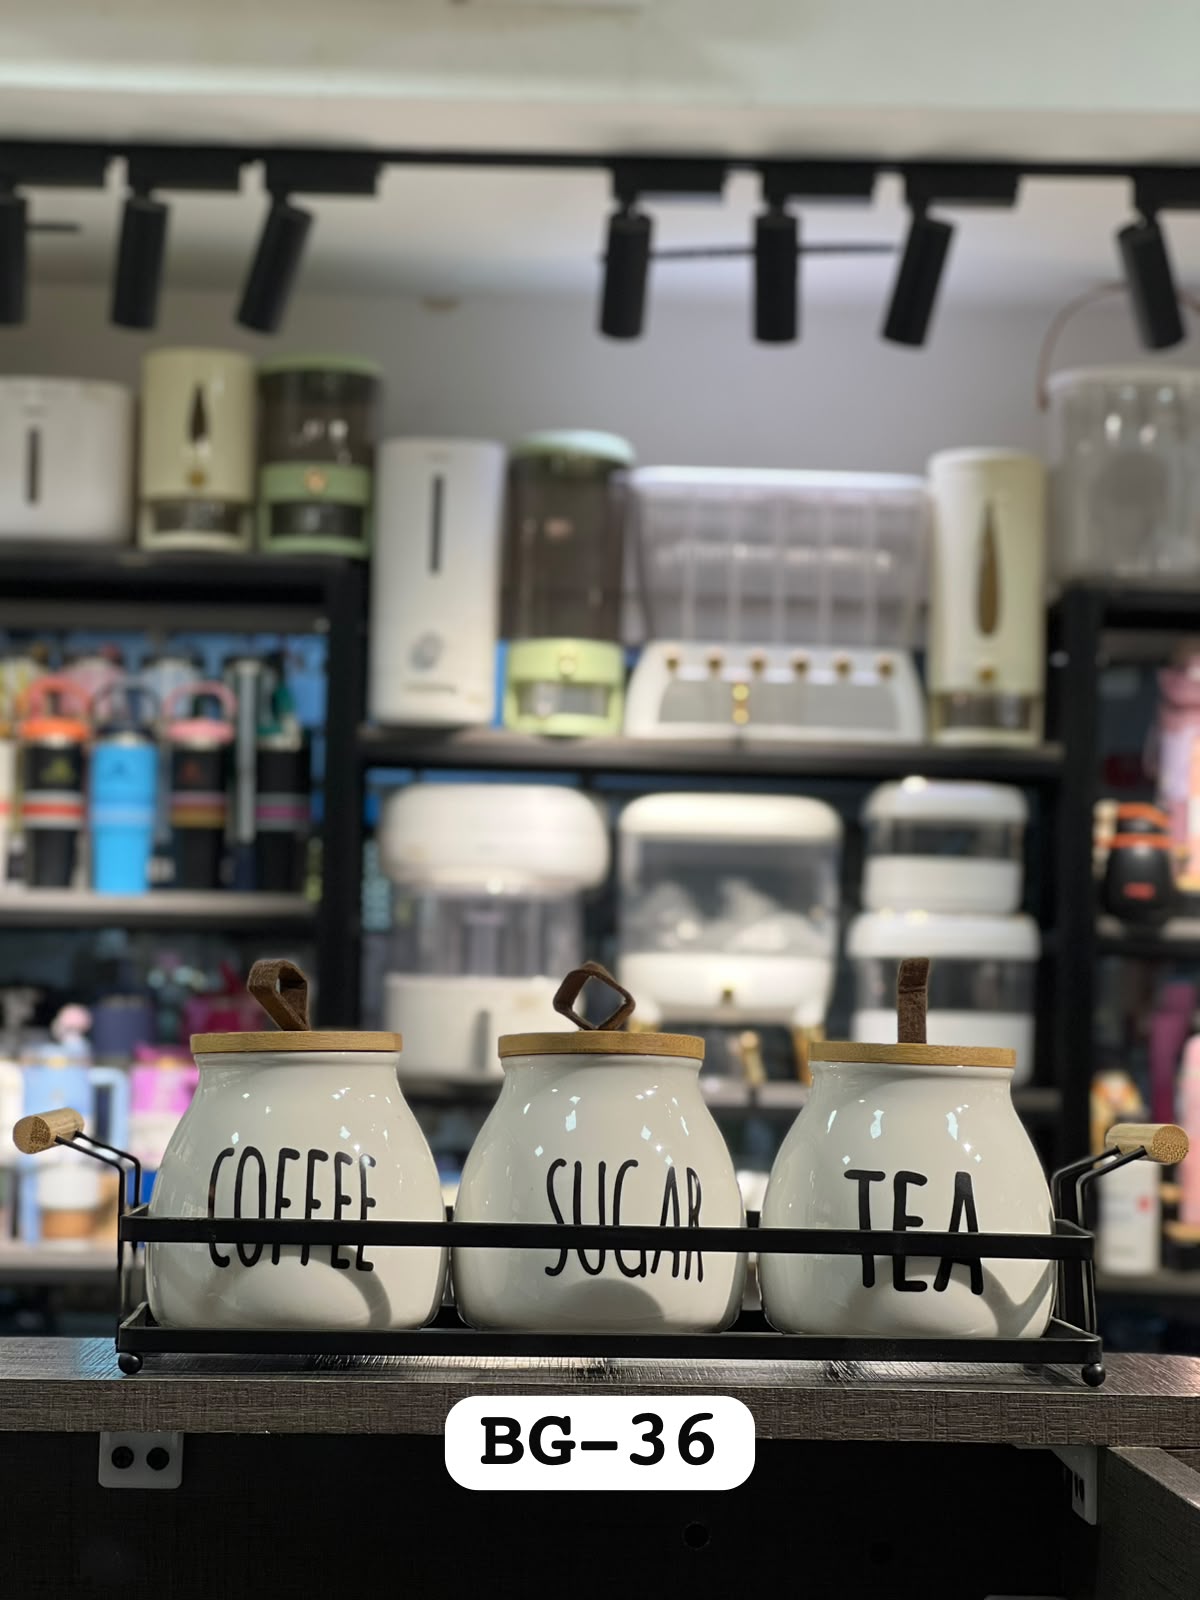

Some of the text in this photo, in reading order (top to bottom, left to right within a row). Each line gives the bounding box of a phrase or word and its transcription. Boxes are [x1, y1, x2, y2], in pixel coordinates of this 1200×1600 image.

[207, 1145, 377, 1272] COFFEE
[544, 1158, 704, 1282] SUGAR
[843, 1169, 984, 1296] TEA
